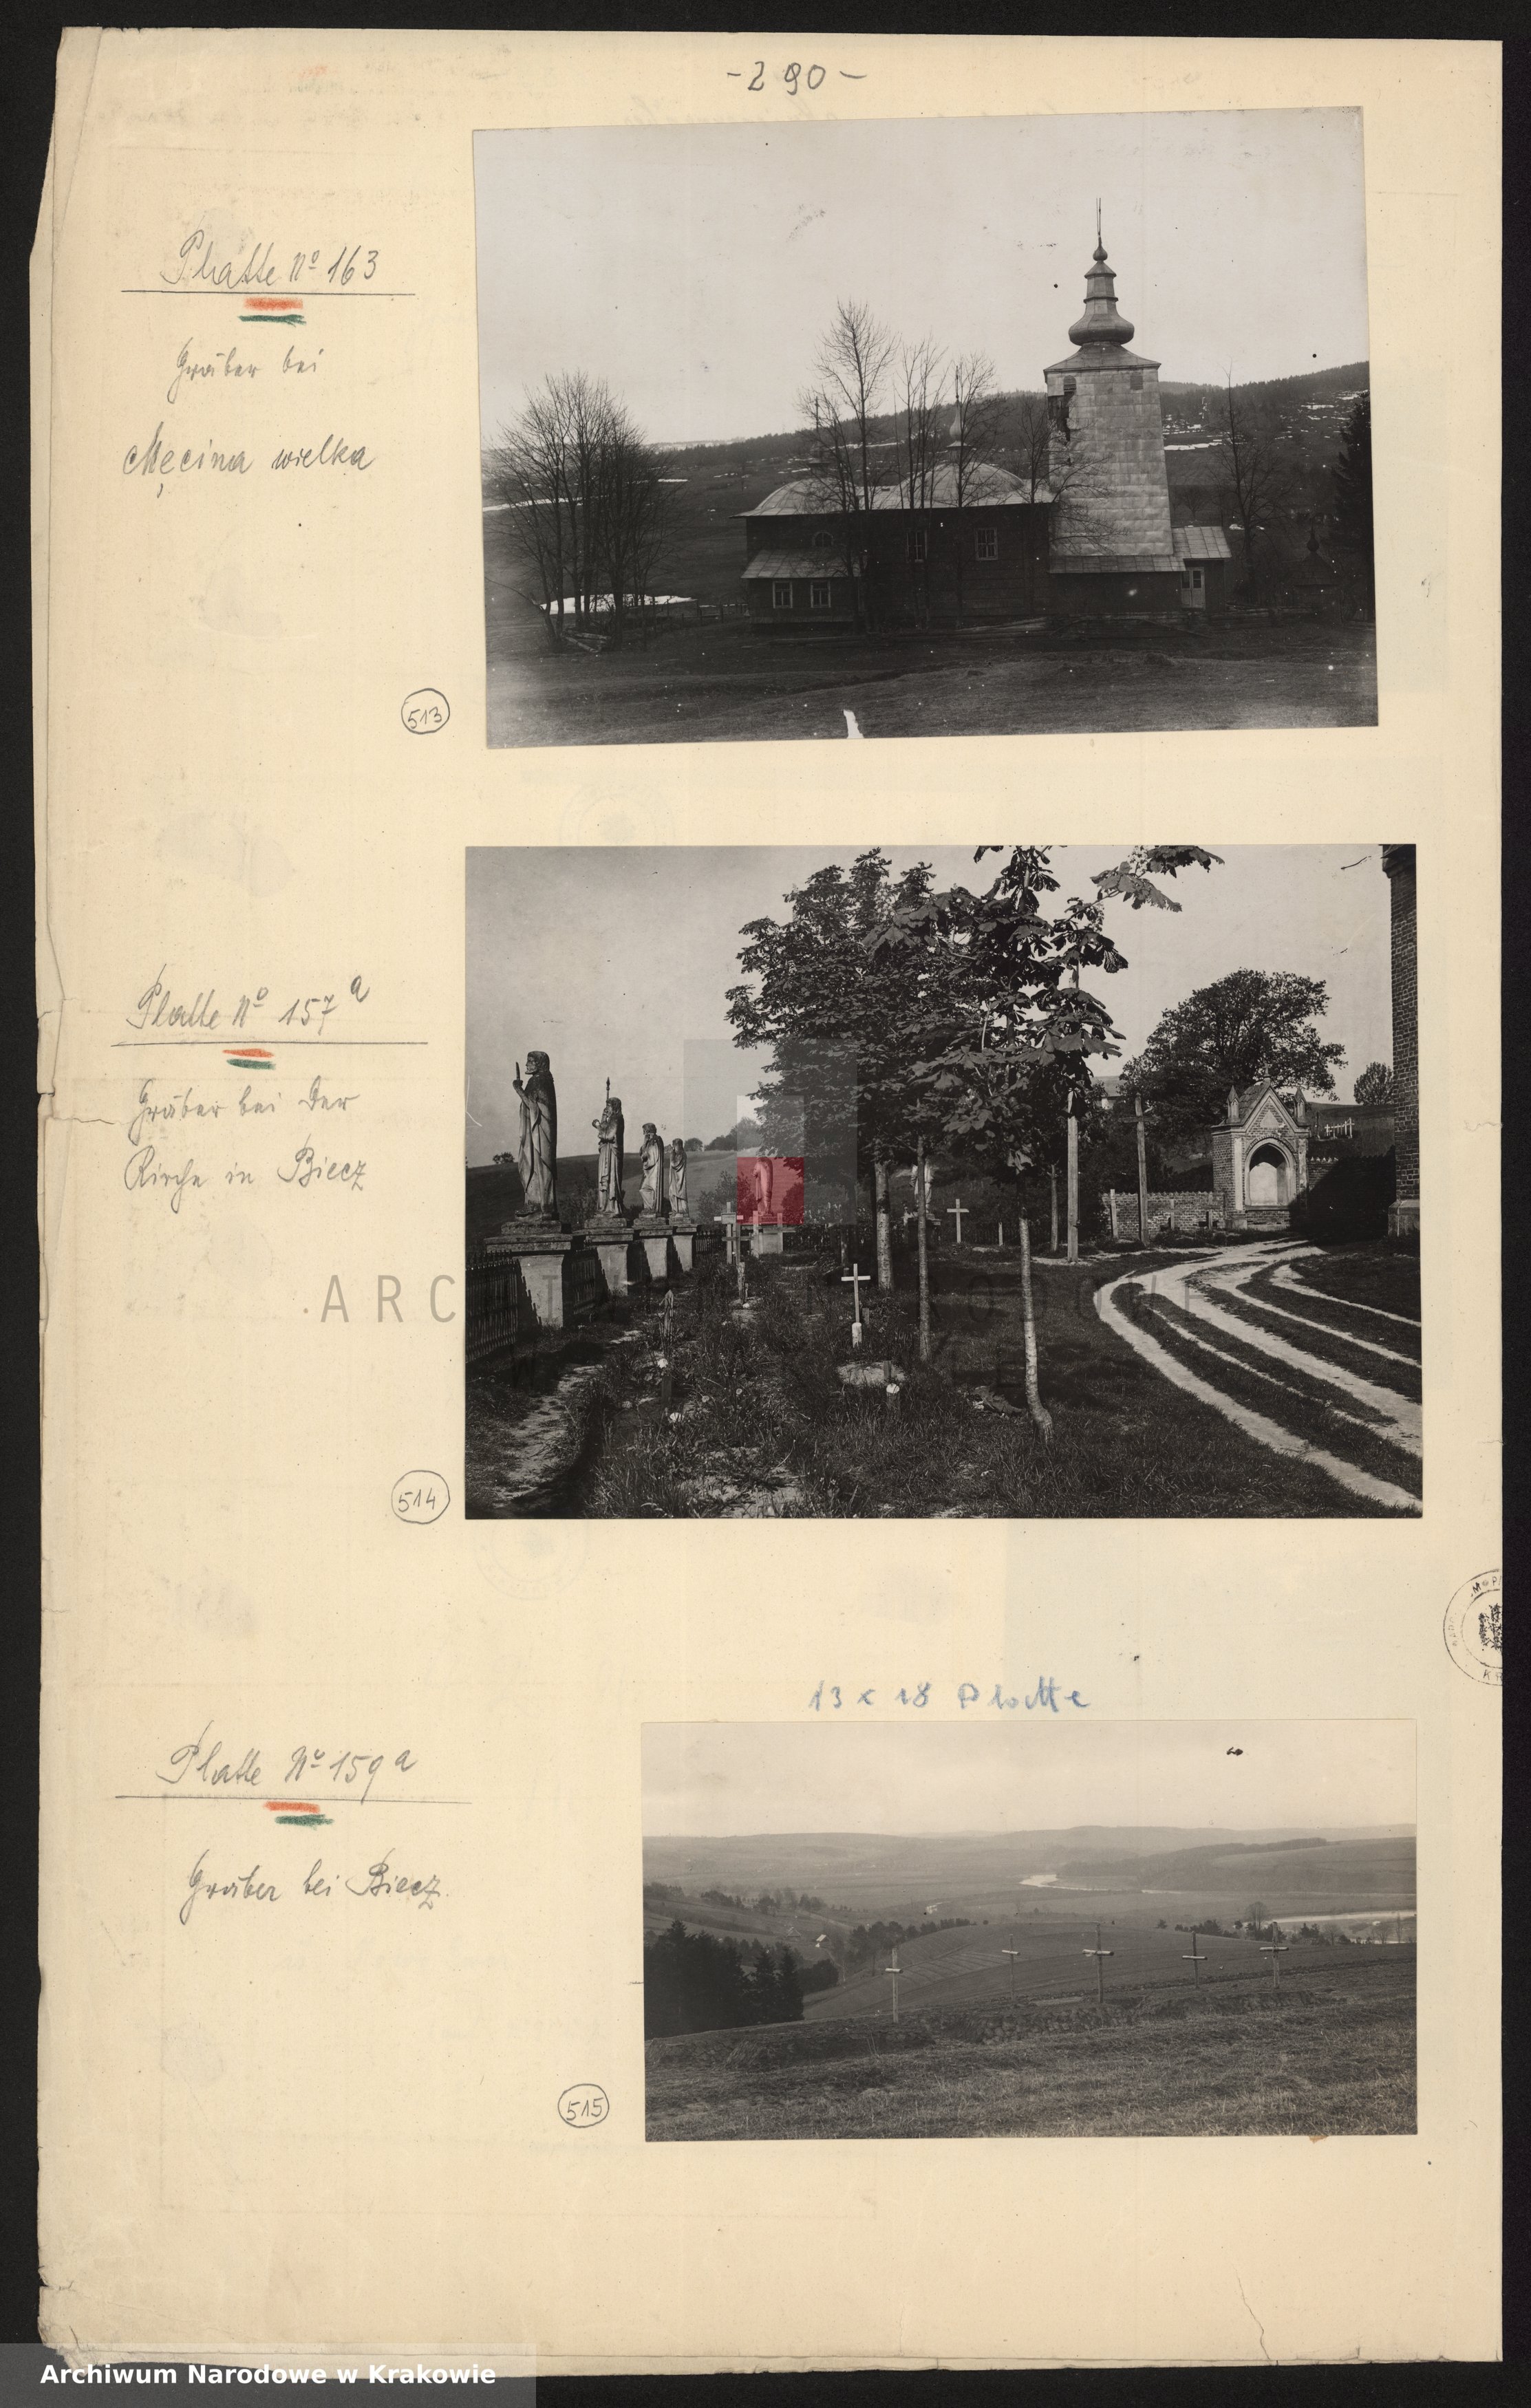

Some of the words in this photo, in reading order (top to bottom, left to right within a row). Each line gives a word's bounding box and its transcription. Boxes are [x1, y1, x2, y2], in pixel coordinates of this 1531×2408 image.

[327, 245, 378, 286] 163
[282, 345, 325, 374] bei
[408, 706, 442, 729] 513
[278, 994, 337, 1035] 157
[224, 1162, 255, 1185] in
[397, 1487, 436, 1512] 514
[809, 1680, 843, 1712] 13
[895, 1681, 932, 1708] 18
[329, 1751, 383, 1804] 159
[303, 1859, 340, 1897] bei
[566, 2099, 603, 2122] 515
